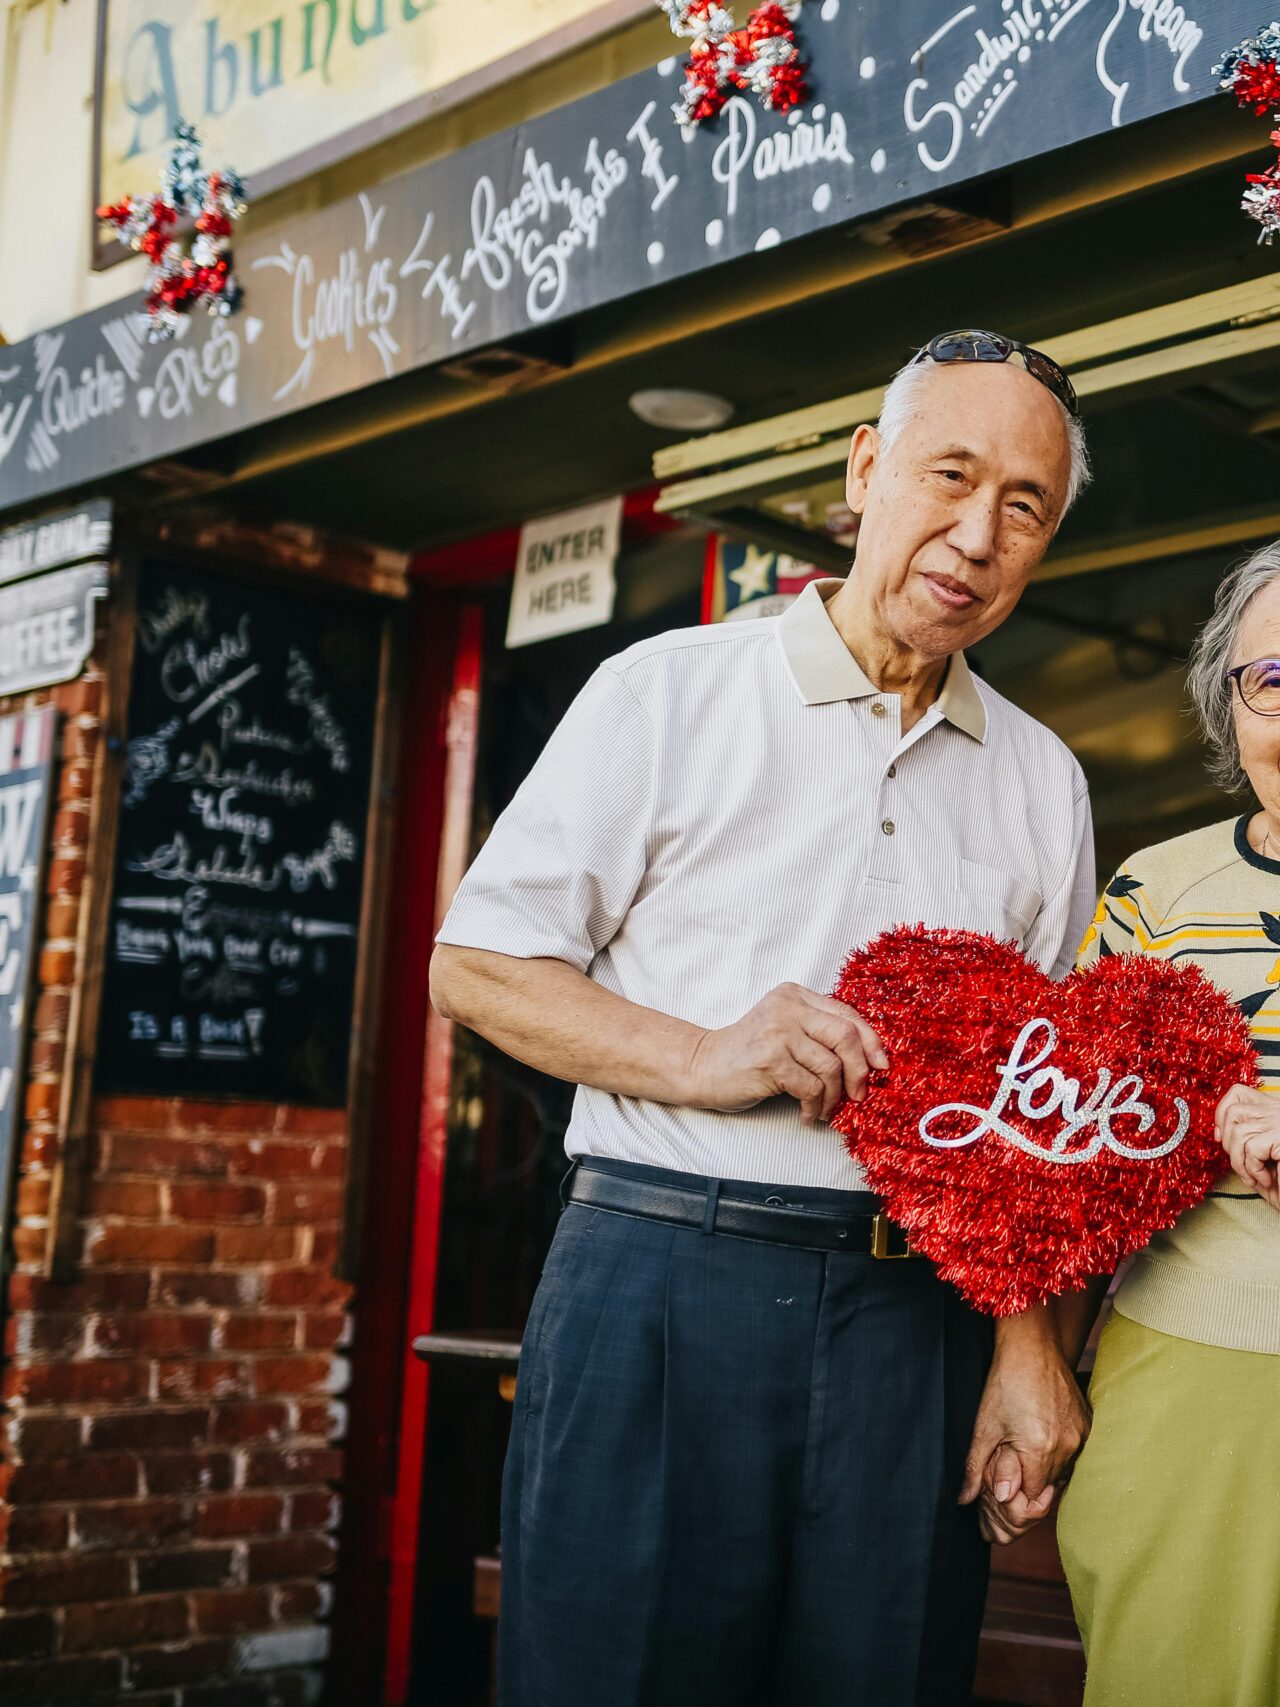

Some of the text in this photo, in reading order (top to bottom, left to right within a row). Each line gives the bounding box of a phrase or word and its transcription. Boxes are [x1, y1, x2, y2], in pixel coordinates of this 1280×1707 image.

[291, 245, 399, 354] Cookies
[41, 353, 126, 436] Quiche
[154, 317, 241, 420] Pies
[525, 525, 605, 575] ENTER
[527, 572, 593, 616] HERE
[919, 1018, 1190, 1164] Love
